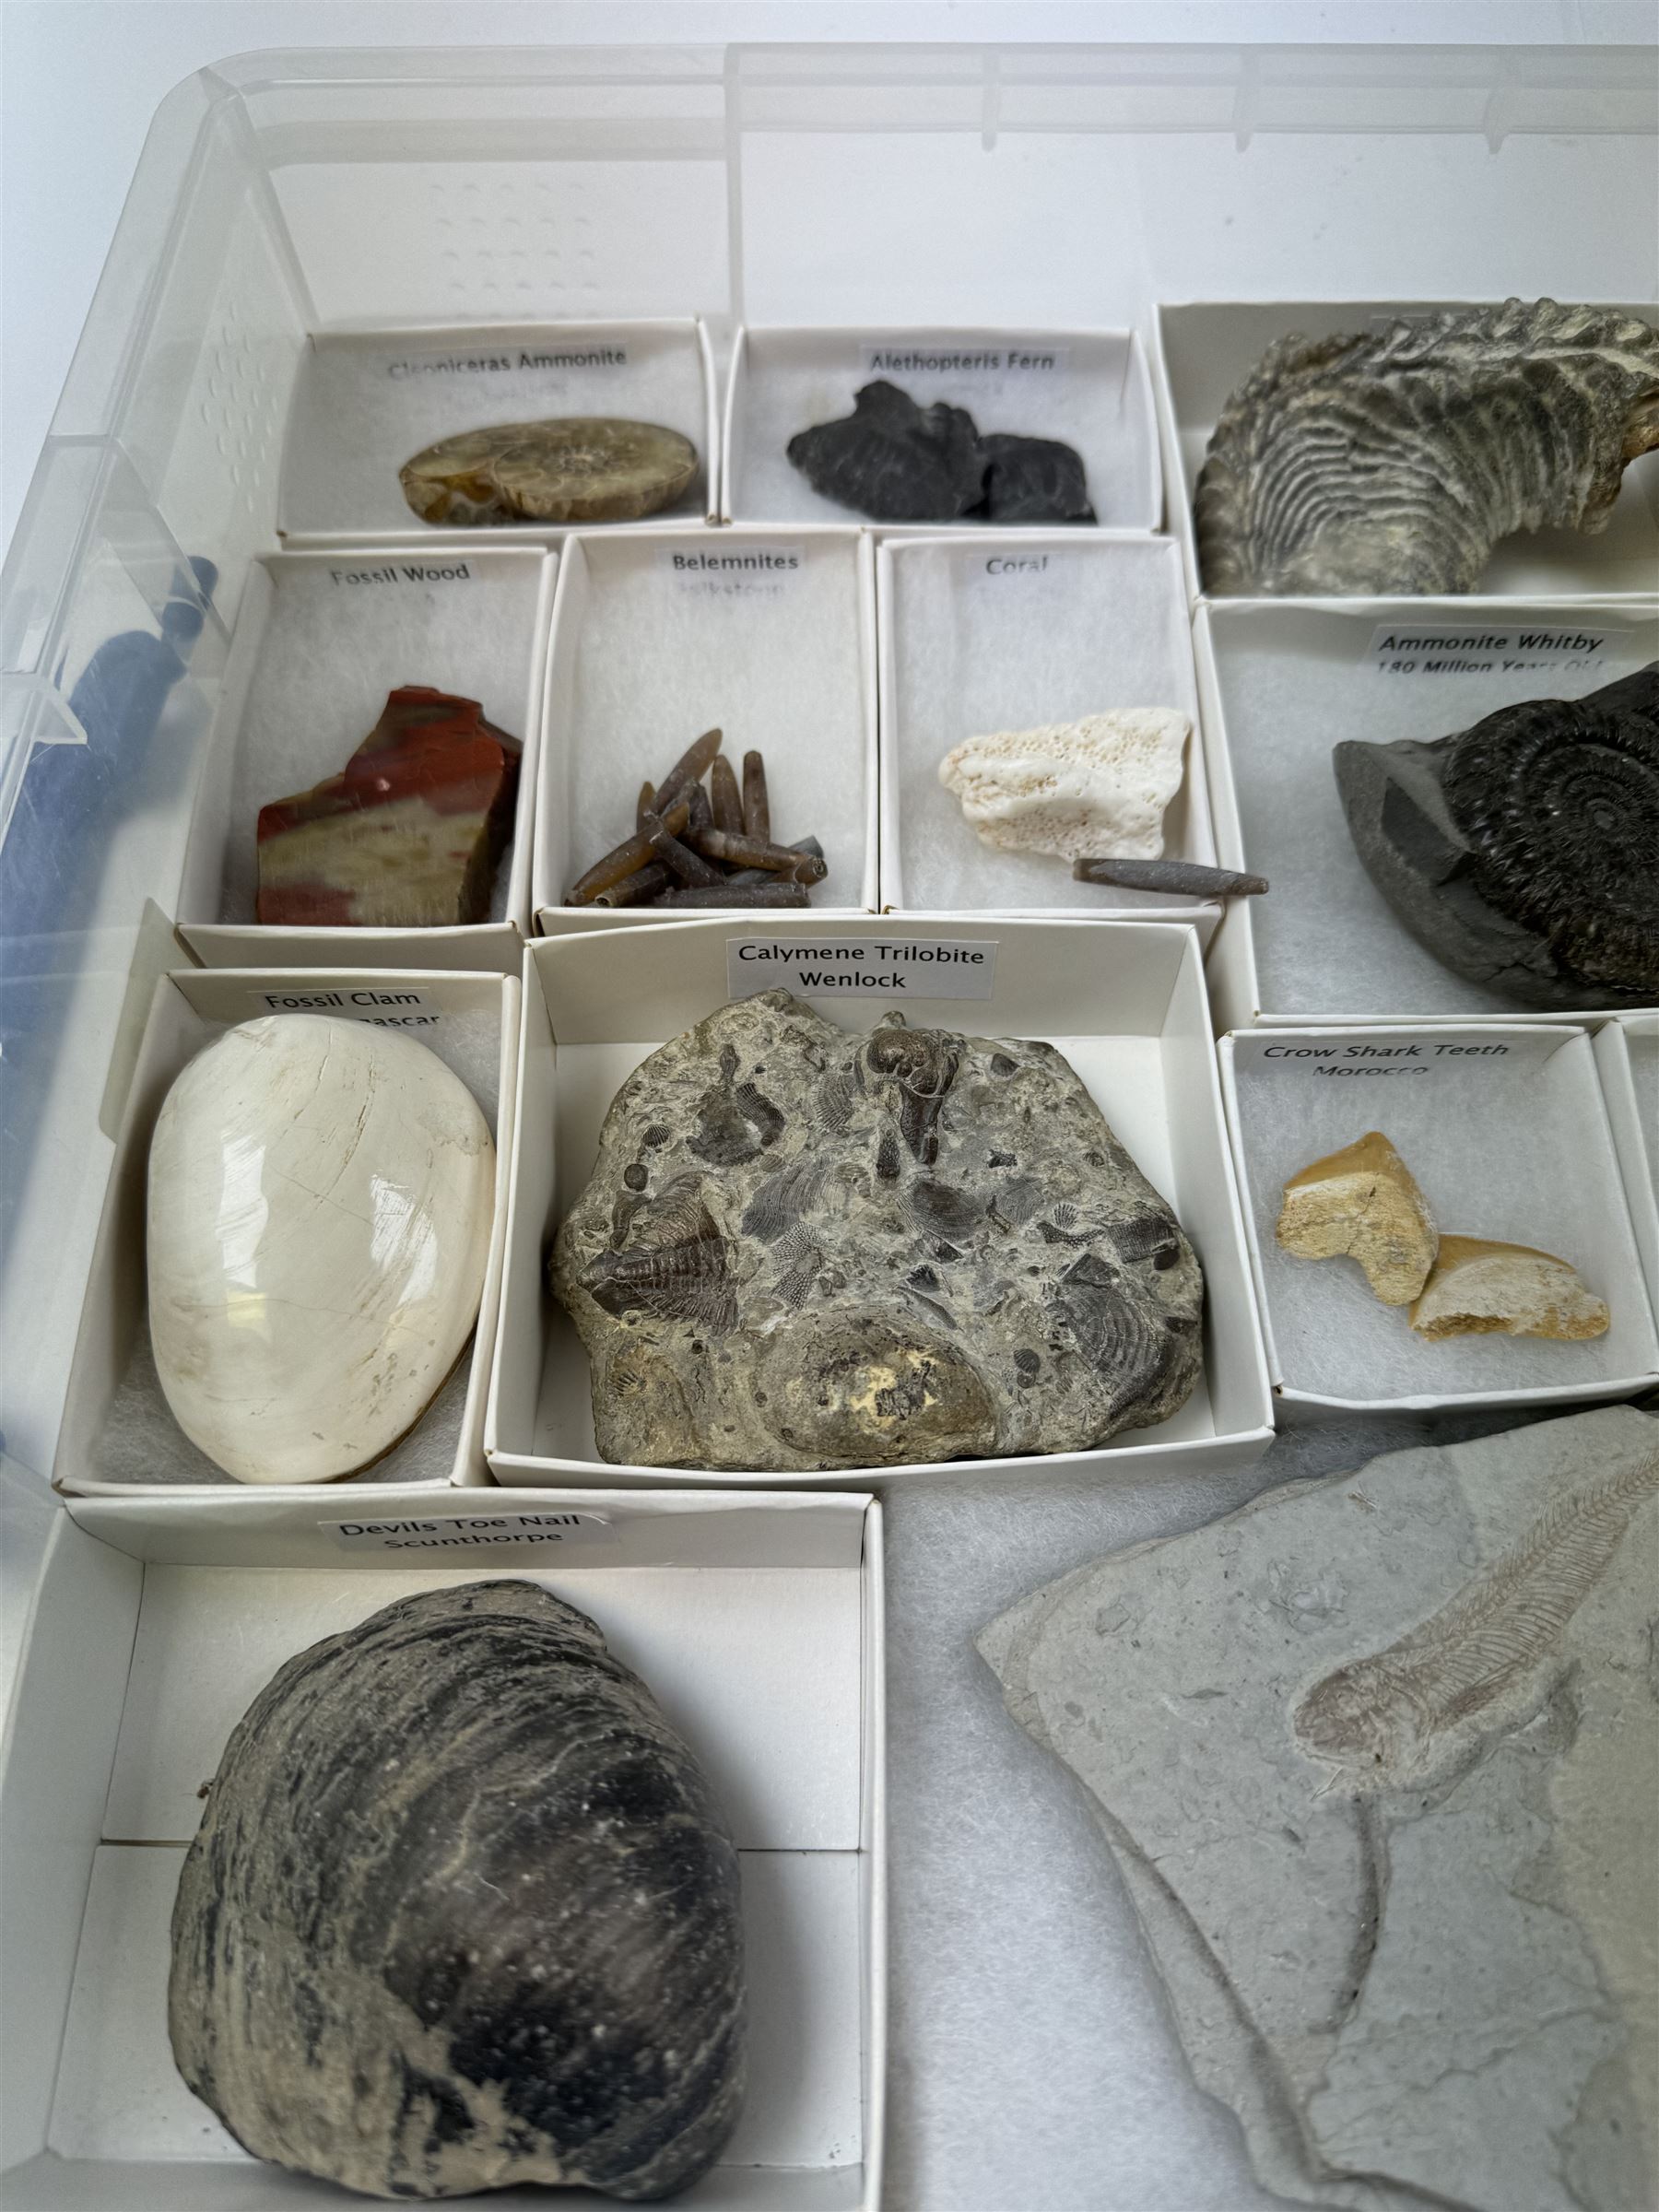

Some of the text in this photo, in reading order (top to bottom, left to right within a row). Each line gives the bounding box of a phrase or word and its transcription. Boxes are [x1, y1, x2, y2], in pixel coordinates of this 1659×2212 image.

[518, 349, 628, 370] Ammonite
[870, 351, 1056, 373] Alethopteris Fern
[673, 554, 799, 571] Belemnites
[985, 555, 1049, 575] Coral
[330, 564, 471, 586] Fossil Wood
[1378, 634, 1604, 654] Ammonite Whitby
[1421, 661, 1492, 674] Million
[738, 945, 984, 964] Calymene Trilobite
[798, 971, 907, 988] Wenlock
[265, 992, 421, 1008] Fossil Clam
[1264, 1044, 1510, 1058] Crow Shark Teeth
[1312, 1065, 1430, 1077] Morocco
[339, 1514, 581, 1536] Devils Toe Nail
[383, 1532, 564, 1549] Scunthorpe
